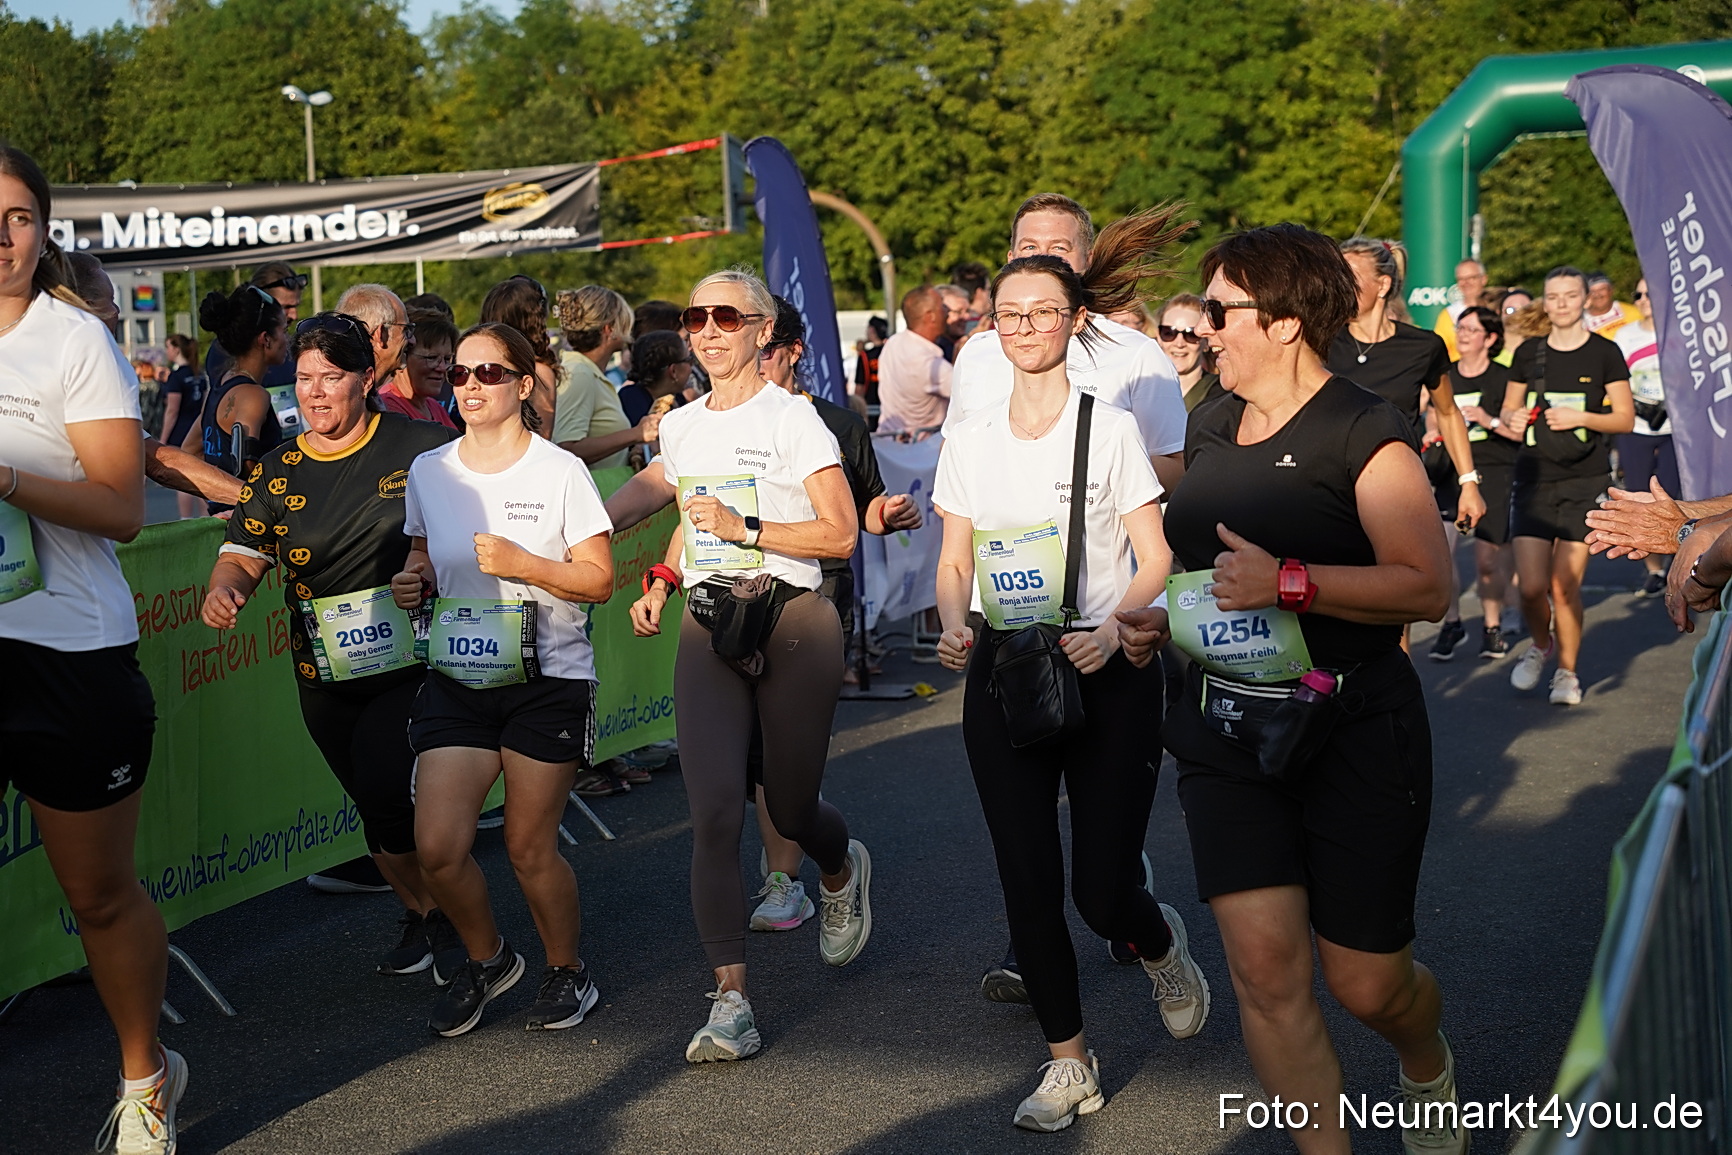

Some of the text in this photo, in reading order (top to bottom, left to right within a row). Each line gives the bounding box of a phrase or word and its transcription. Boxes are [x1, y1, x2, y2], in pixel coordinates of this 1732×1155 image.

[101, 204, 420, 249] Miteinander.
[1408, 286, 1448, 306] AOK
[0, 394, 41, 407] emeinde
[0, 406, 35, 422] eining
[735, 447, 772, 458] Gemeinde
[738, 458, 767, 470] Deining
[1055, 482, 1100, 491] Gemnde
[504, 501, 545, 510] Gemeinde
[507, 512, 538, 522] Deining
[695, 539, 714, 547] Petra
[990, 569, 1044, 592] 1035
[998, 595, 1050, 606] Ronja Winter
[336, 621, 393, 648] 2096
[1197, 615, 1271, 647] 1254
[347, 649, 367, 659] Gaby
[367, 643, 394, 654] Gerner
[447, 636, 499, 657] 1034
[1206, 646, 1278, 662] Dagmar Feihl
[435, 659, 517, 670] Melanie Moosburger
